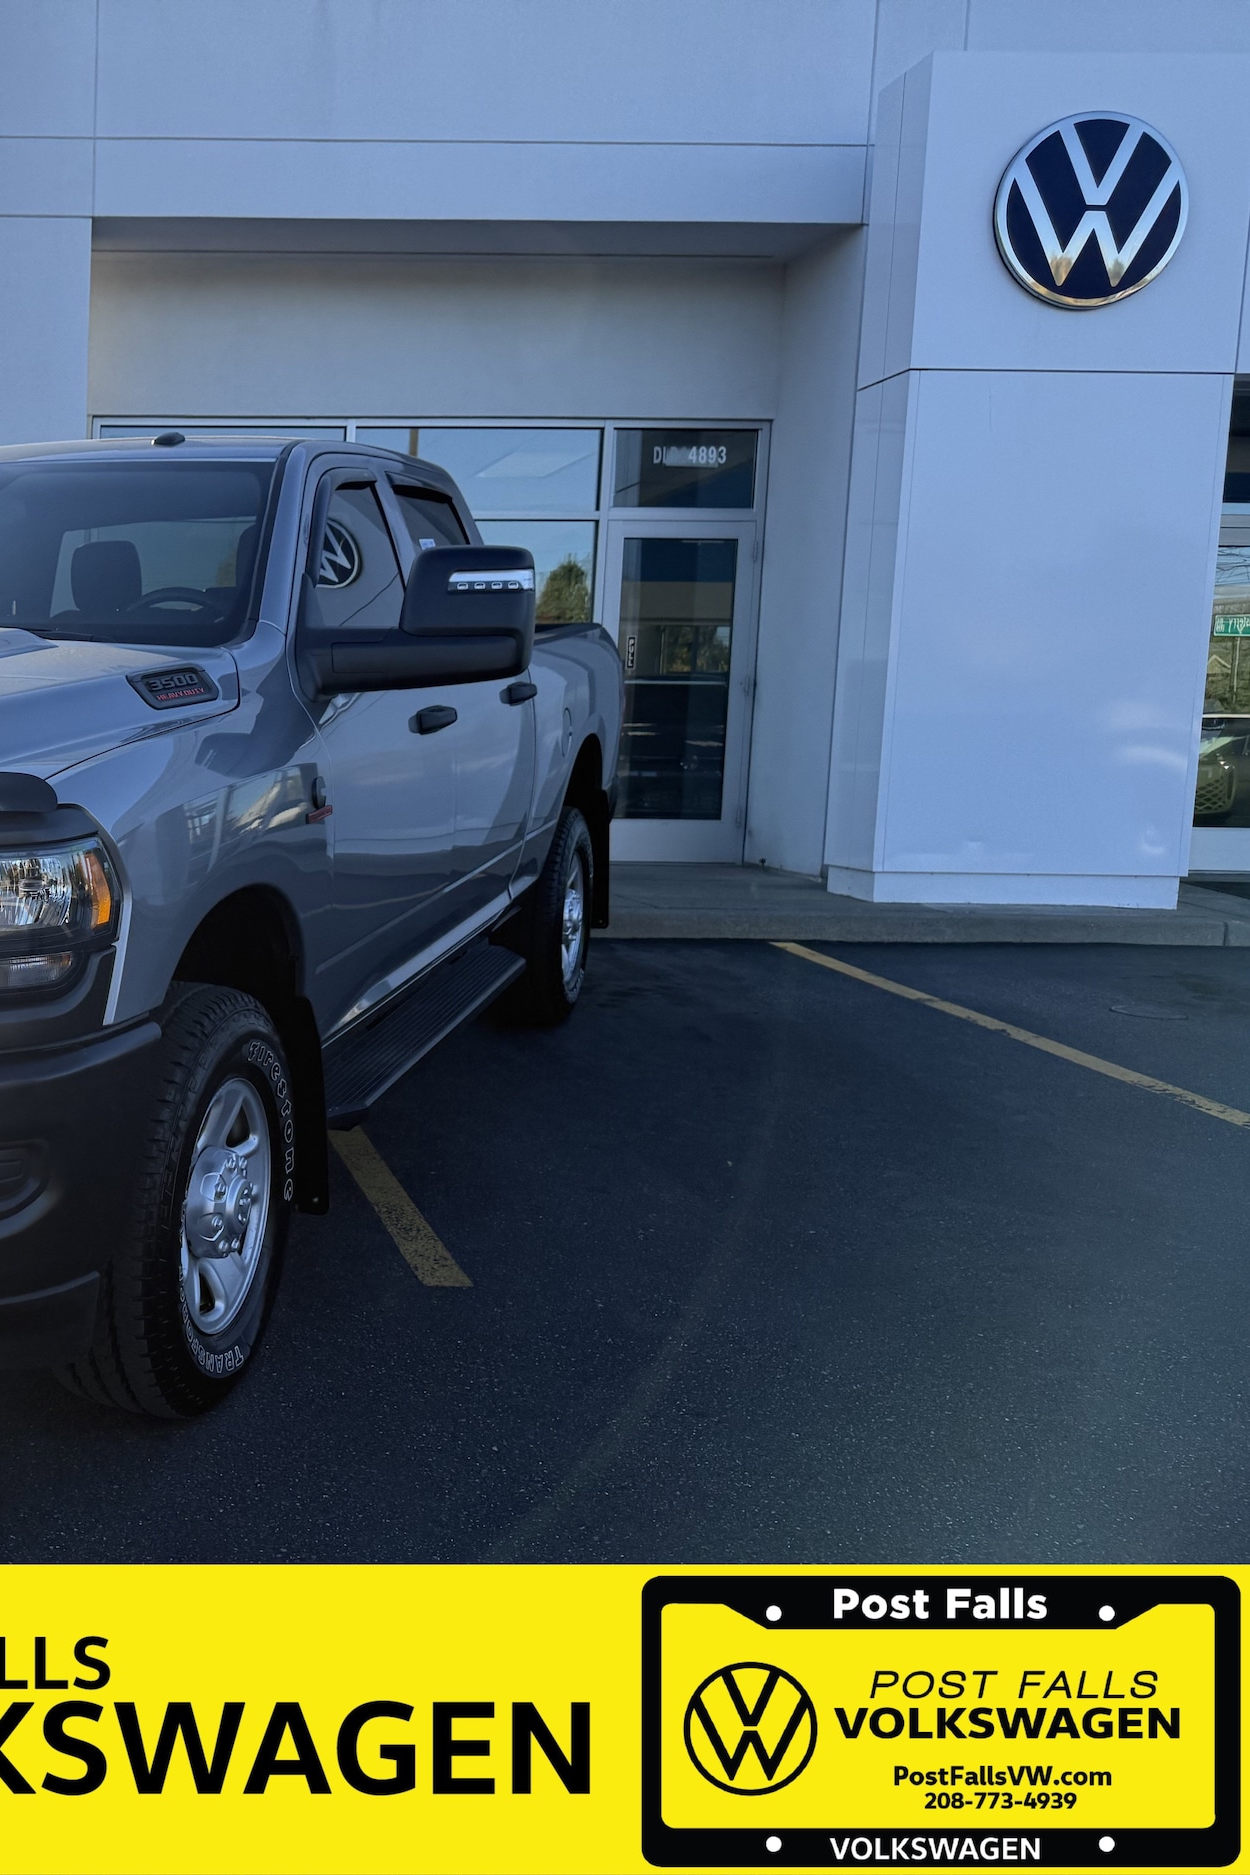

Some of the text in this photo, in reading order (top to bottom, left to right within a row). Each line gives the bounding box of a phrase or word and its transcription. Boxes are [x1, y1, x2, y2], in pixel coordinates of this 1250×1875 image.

[149, 673, 198, 691] 3500
[156, 687, 205, 701] HEAVY DUTY
